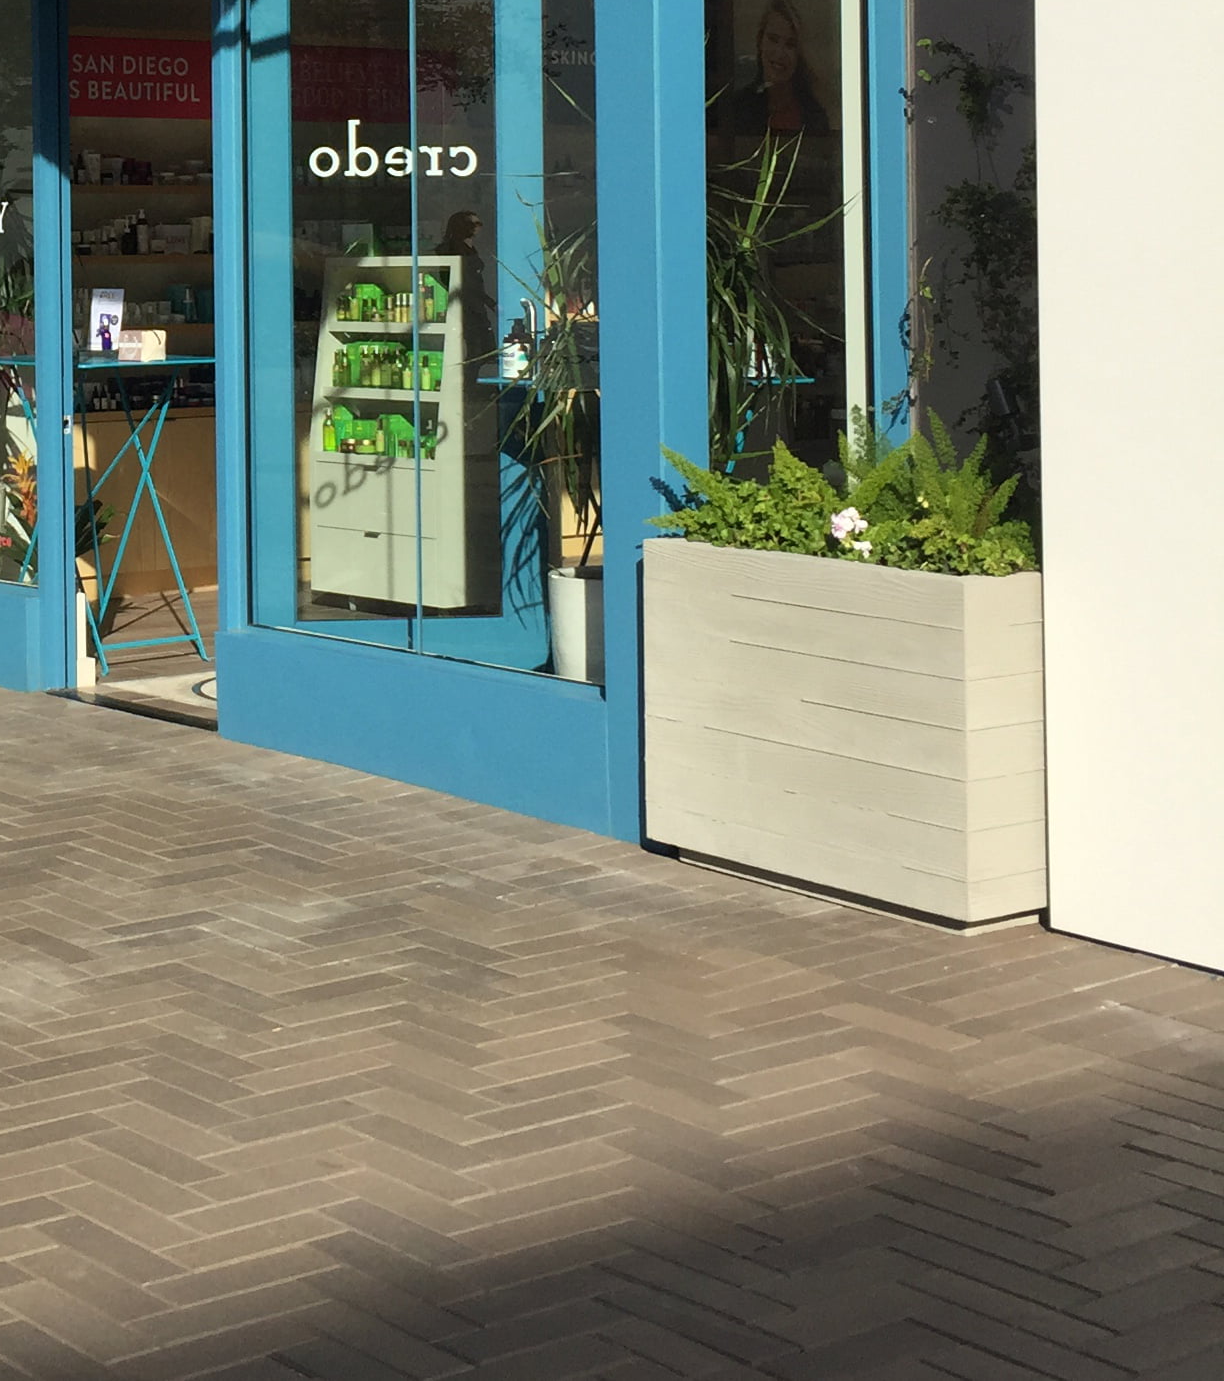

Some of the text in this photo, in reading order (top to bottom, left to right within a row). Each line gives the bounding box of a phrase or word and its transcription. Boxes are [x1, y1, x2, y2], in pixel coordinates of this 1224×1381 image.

[72, 54, 189, 76] SAN DIEGO
[69, 80, 200, 103] S BEAUTIFUL
